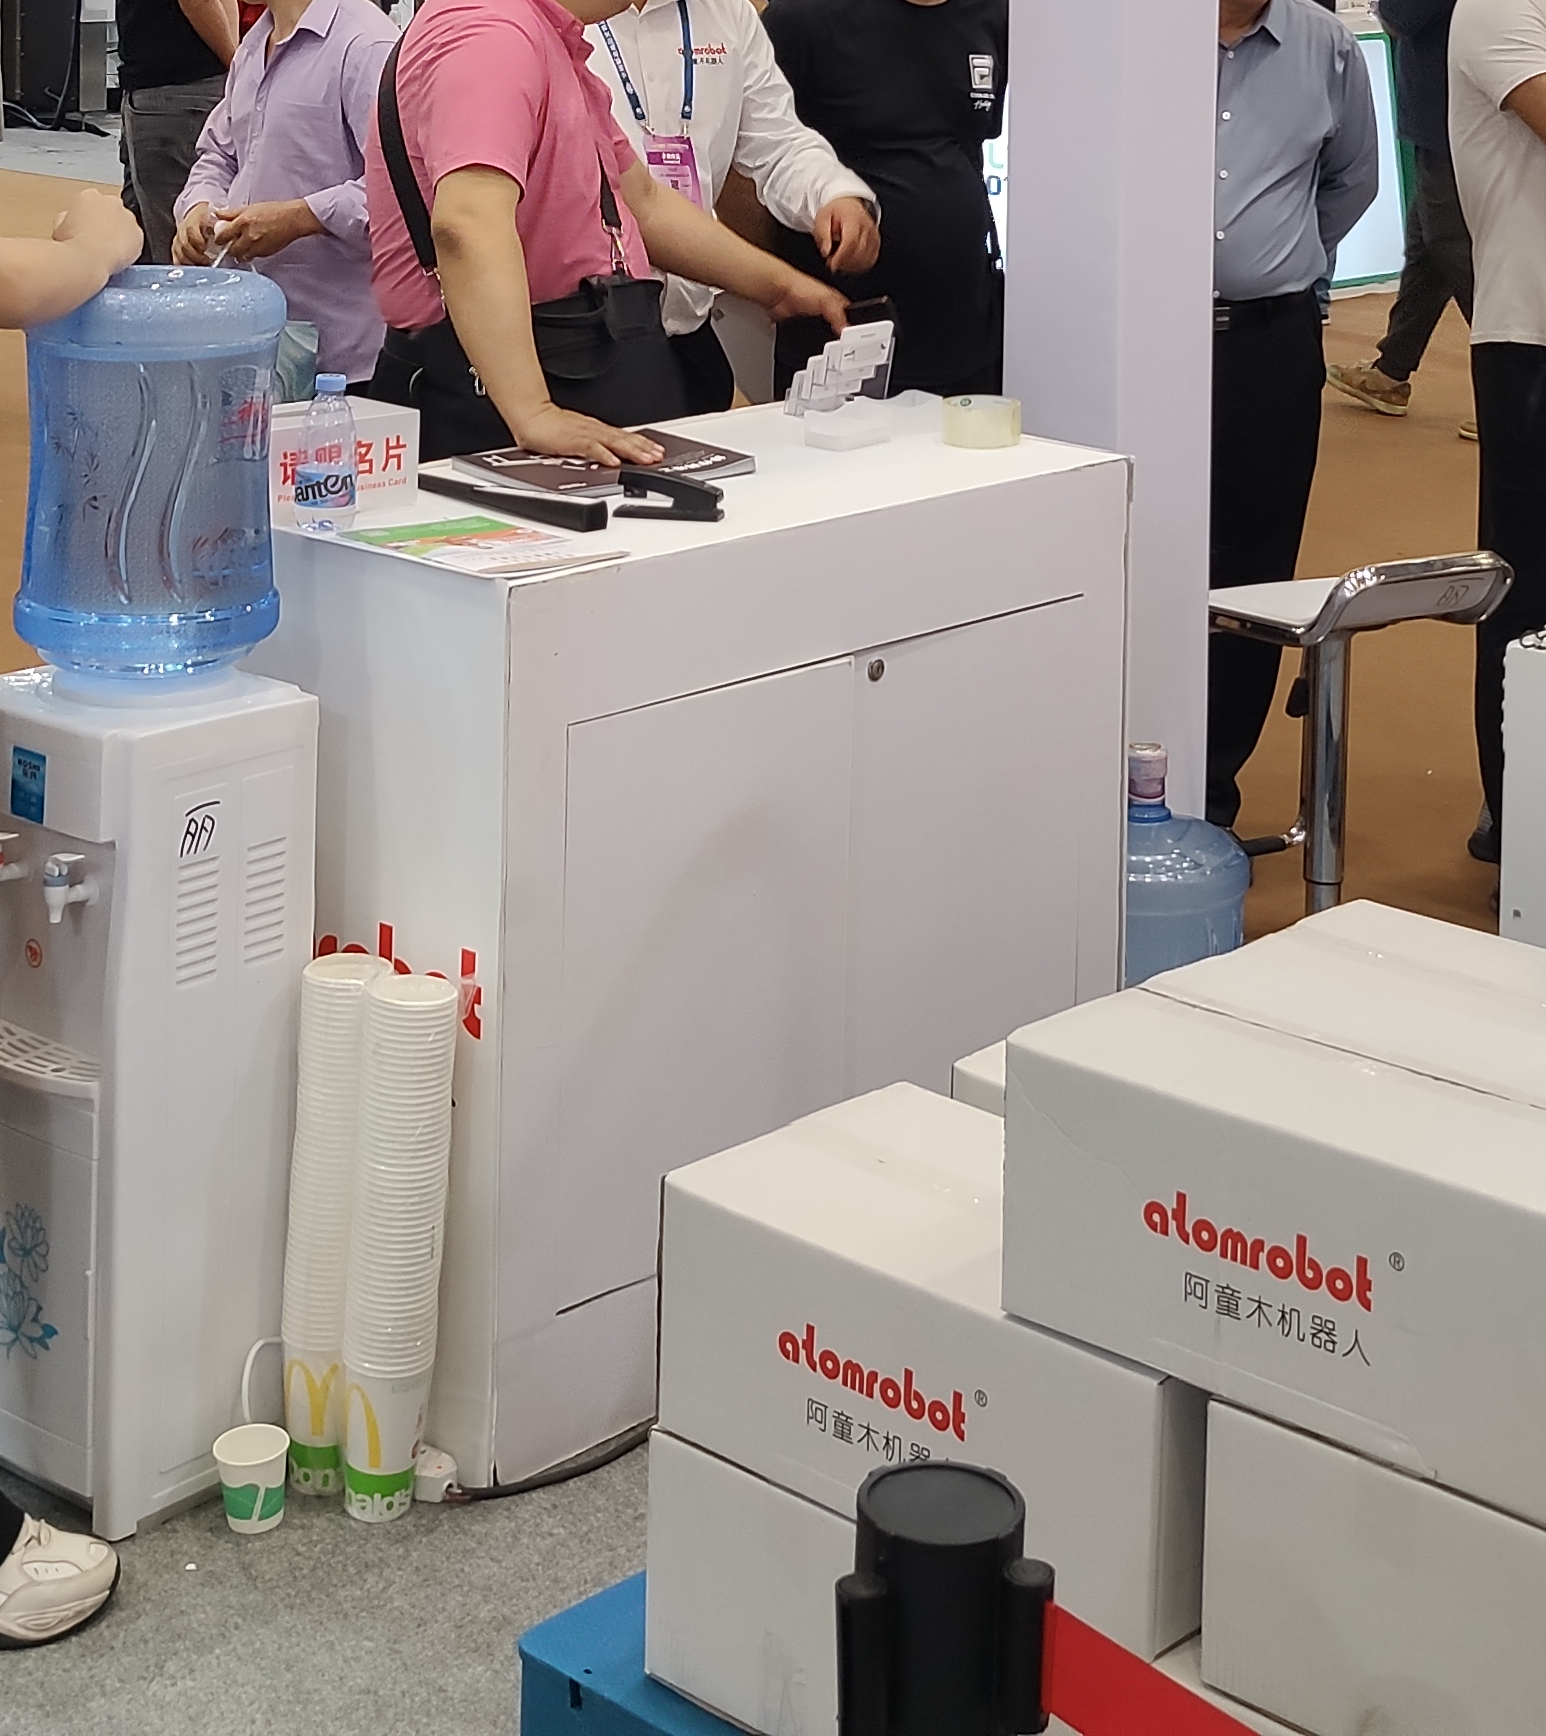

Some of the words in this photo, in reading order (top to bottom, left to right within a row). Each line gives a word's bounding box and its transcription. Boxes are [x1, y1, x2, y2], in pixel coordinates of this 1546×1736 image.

[387, 476, 408, 487] Card
[1142, 1189, 1374, 1314] atomrobot
[1182, 1270, 1374, 1369] 阿童木机器人
[777, 1322, 969, 1444] atomrobot
[804, 1396, 955, 1463] 阿童木机器
